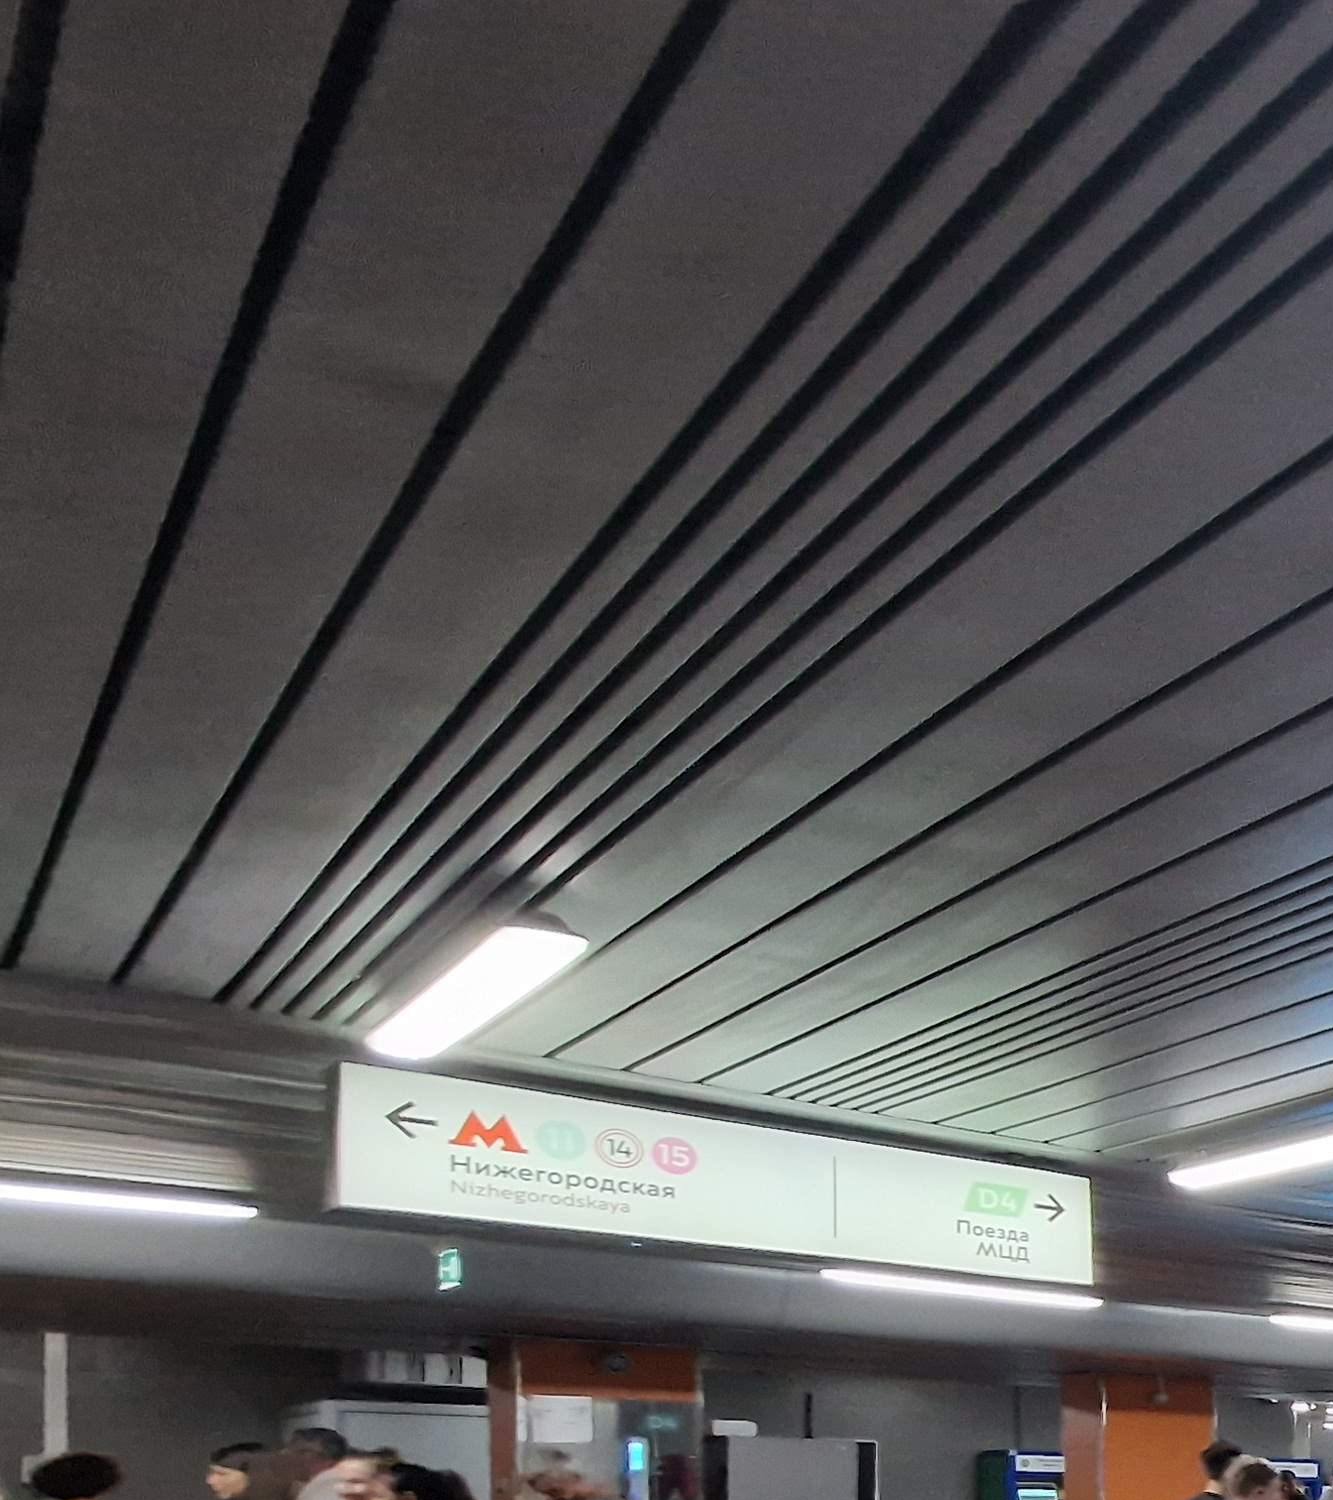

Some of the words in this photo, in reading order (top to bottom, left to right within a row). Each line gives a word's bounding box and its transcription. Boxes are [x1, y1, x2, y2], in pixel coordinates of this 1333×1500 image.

[606, 1138, 633, 1159] 14
[657, 1143, 690, 1168] 15
[450, 1154, 676, 1199] Нижегородская
[450, 1180, 632, 1214] Nizhegorodskaya
[957, 1219, 1030, 1243] Поезда
[976, 1242, 1031, 1264] МЦД
